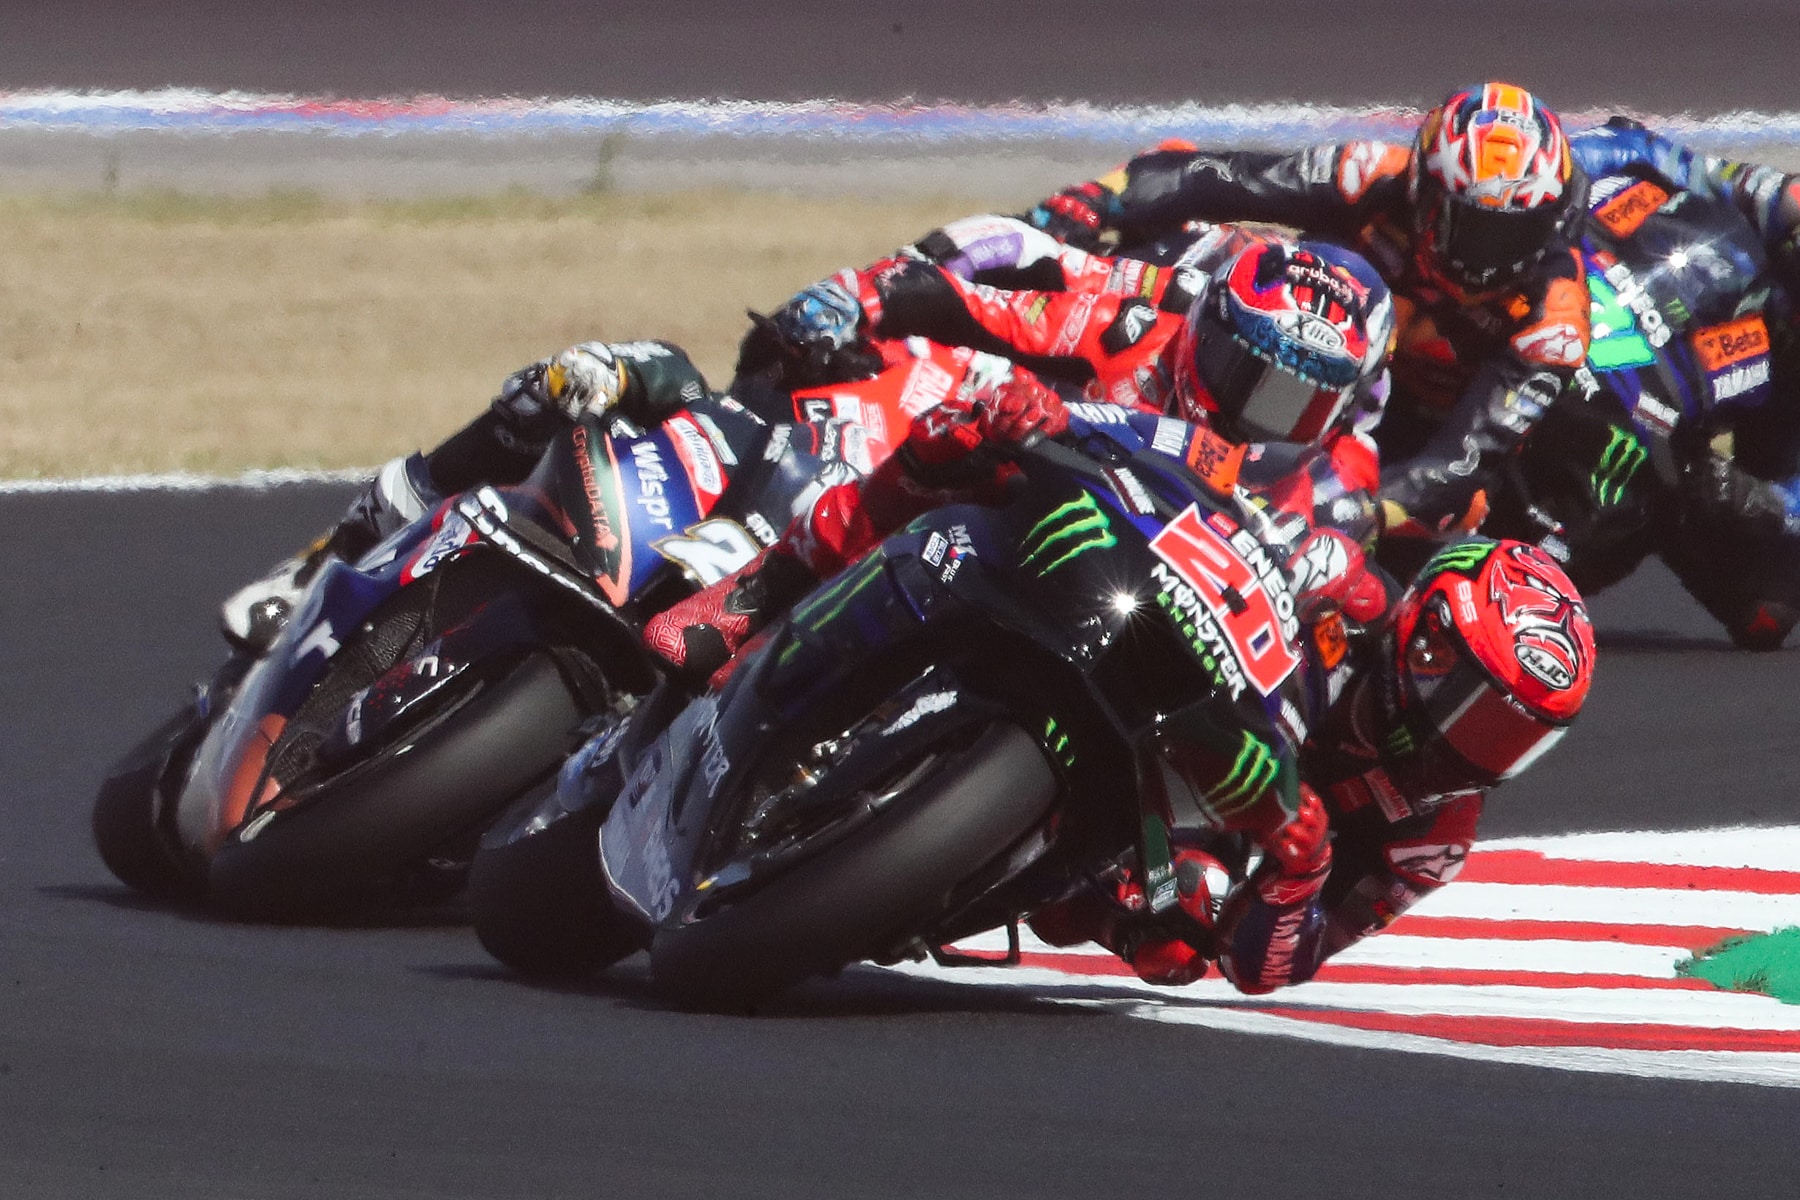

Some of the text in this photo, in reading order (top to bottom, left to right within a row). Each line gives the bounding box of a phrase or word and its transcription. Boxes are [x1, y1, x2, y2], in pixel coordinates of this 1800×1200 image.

[1148, 501, 1302, 698] 20
[1150, 562, 1247, 702] MONSTER
[1156, 591, 1225, 685] ENERGY
[1230, 529, 1301, 643] ENEOS
[1521, 650, 1569, 684] HJC
